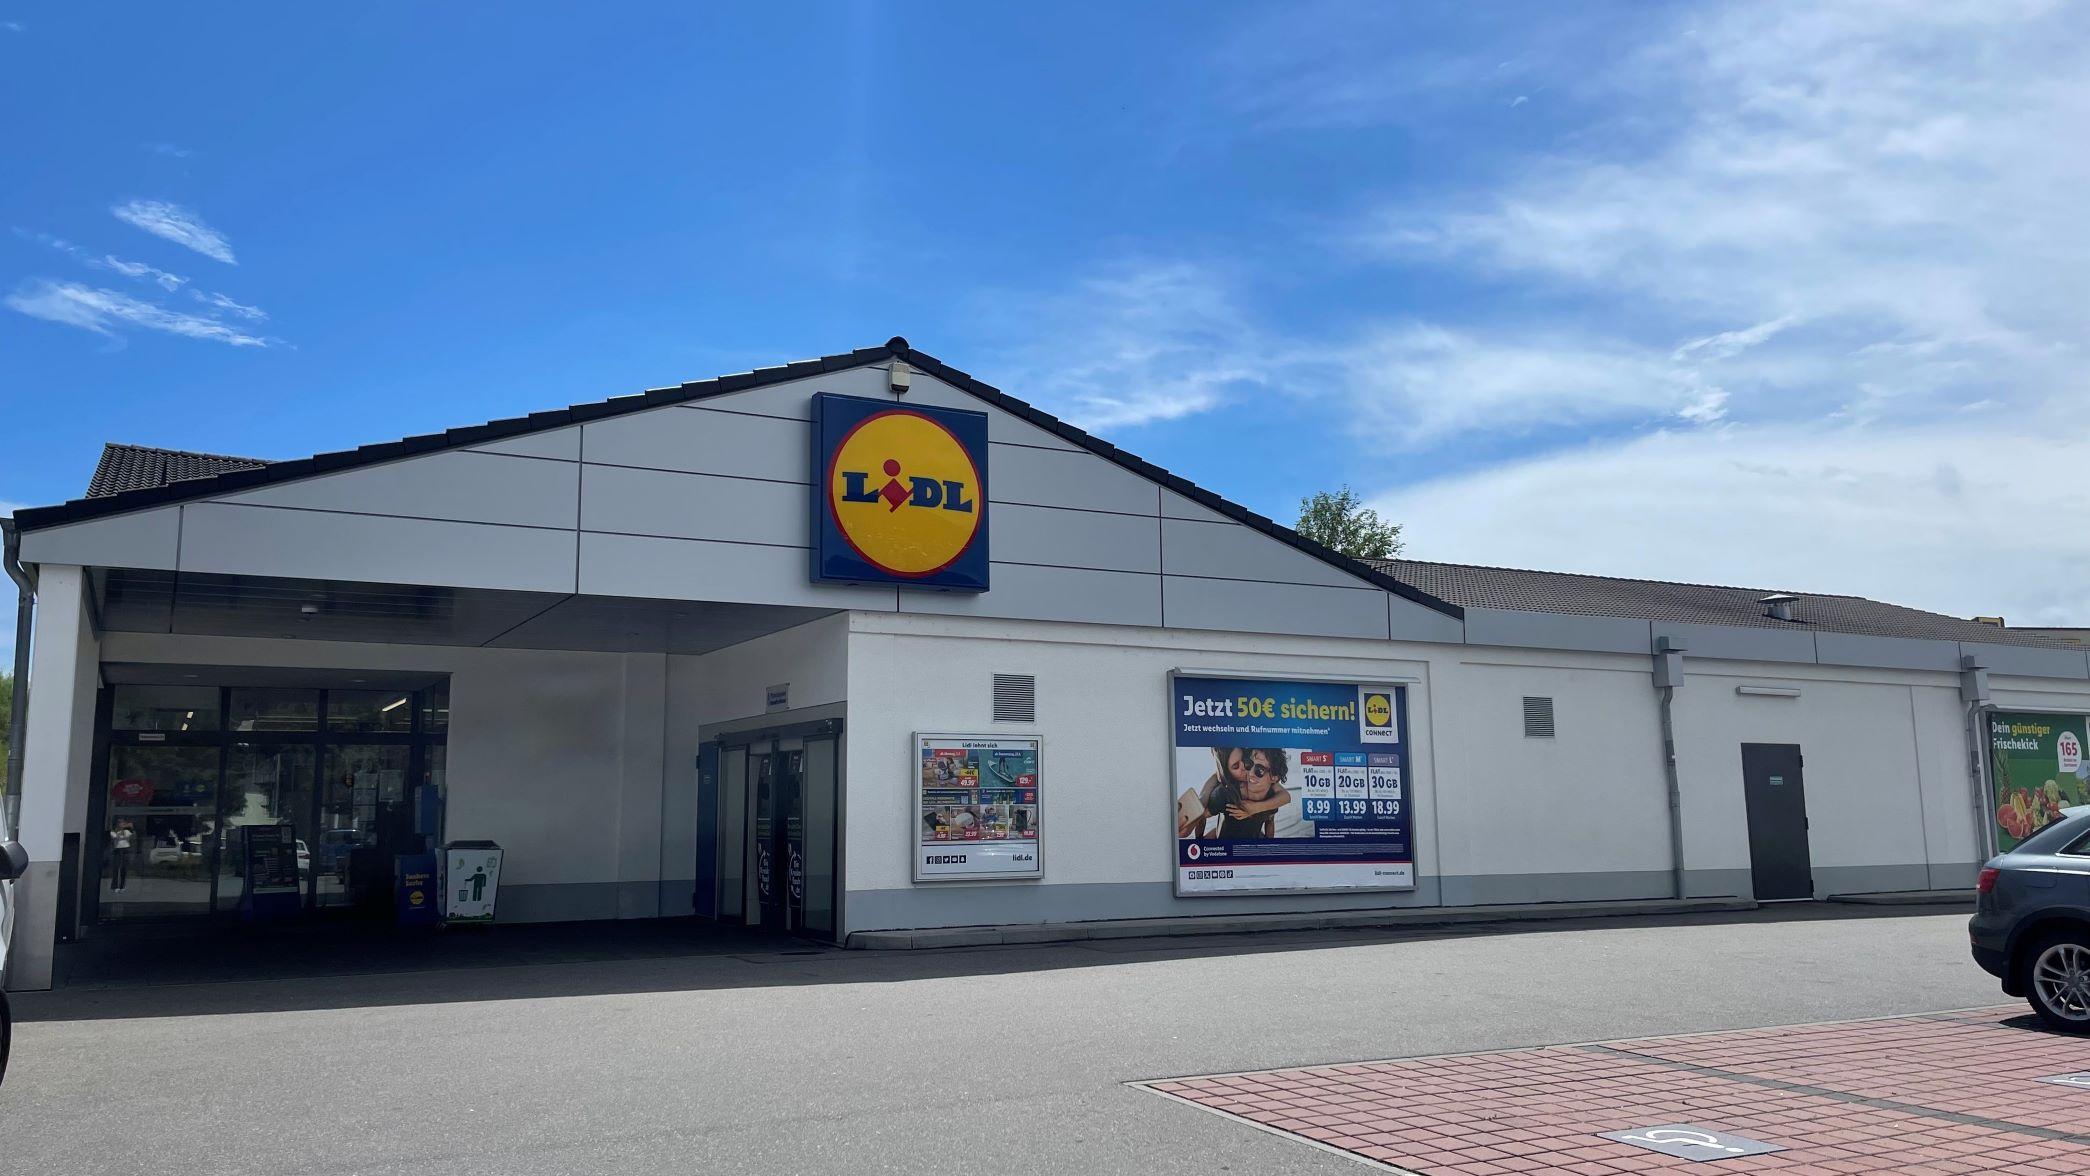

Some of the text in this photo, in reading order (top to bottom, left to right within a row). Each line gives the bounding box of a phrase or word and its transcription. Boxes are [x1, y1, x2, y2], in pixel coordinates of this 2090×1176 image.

[842, 459, 972, 513] LIDL
[1183, 696, 1356, 721] Jetzt 50€ sichern!
[1367, 703, 1389, 714] LIDL
[1183, 723, 1202, 732] Jetzt
[1202, 724, 1235, 733] wechseln
[1236, 725, 1250, 733] und
[1250, 725, 1290, 734] Rufnummer
[1992, 721, 2051, 737] Dein günstiger
[1993, 738, 2039, 750] Frischekick
[2060, 742, 2078, 756] 165
[1304, 775, 1331, 788] 10 GB
[1338, 775, 1365, 788] 20 GB
[1371, 776, 1398, 789] 30 GB
[1306, 800, 1331, 814] 8.99
[1338, 800, 1367, 814] 13.99
[1371, 801, 1400, 815] 18.99
[1012, 854, 1033, 862] lidl.de
